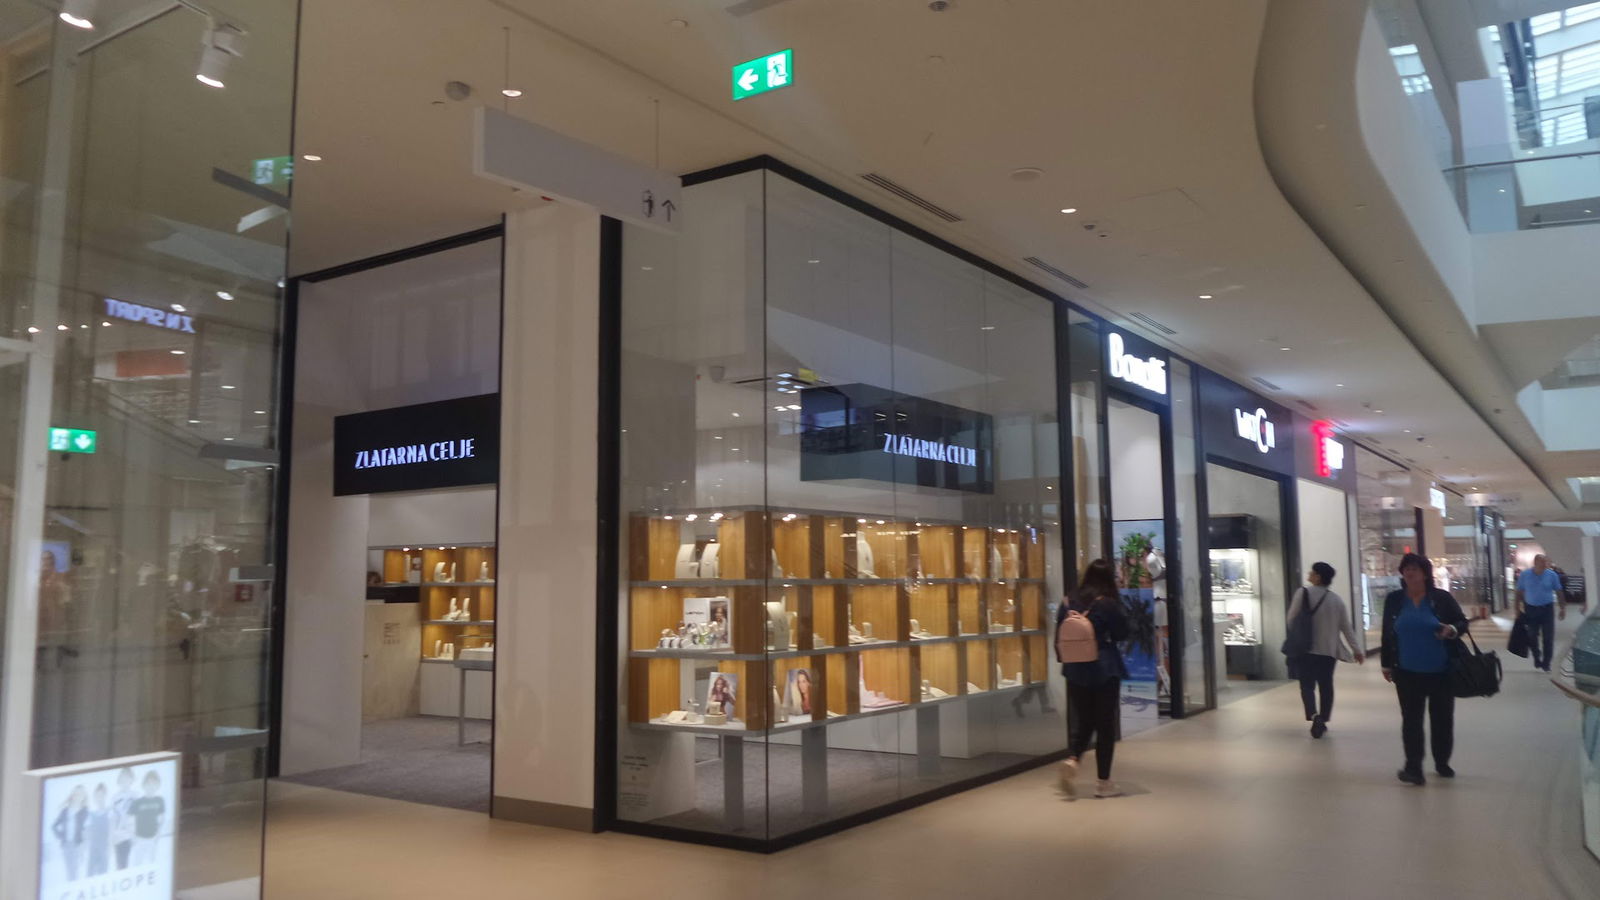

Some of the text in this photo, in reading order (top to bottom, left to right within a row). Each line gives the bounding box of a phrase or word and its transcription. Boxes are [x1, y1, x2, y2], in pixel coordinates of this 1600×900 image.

[354, 438, 475, 470] ZLATARNA CELJE
[883, 432, 946, 462] ZLATARNA
